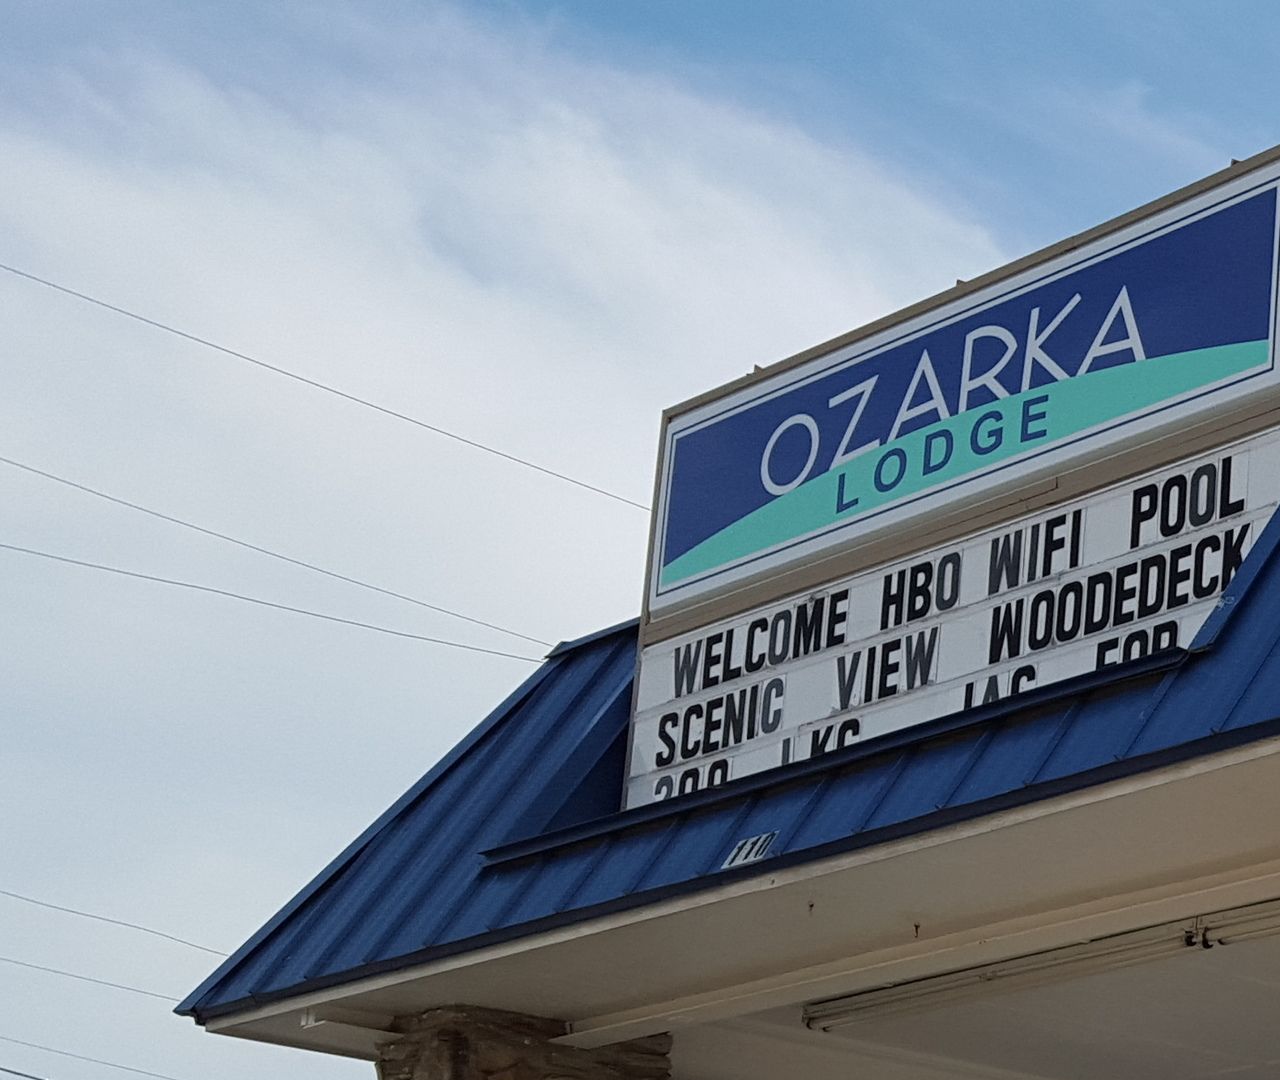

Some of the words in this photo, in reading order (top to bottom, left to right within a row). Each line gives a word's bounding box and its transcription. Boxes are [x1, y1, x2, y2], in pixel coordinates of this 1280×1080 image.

[760, 285, 1147, 496] OZARKA
[835, 395, 1049, 514] LODGE
[656, 678, 784, 767] SCENIC
[837, 627, 939, 710] VIEW
[989, 523, 1251, 664] WOODEDECK
[674, 588, 849, 698] WELCOME
[880, 551, 961, 631] HBO
[988, 509, 1082, 595] WIFI
[1130, 456, 1245, 549] POOL
